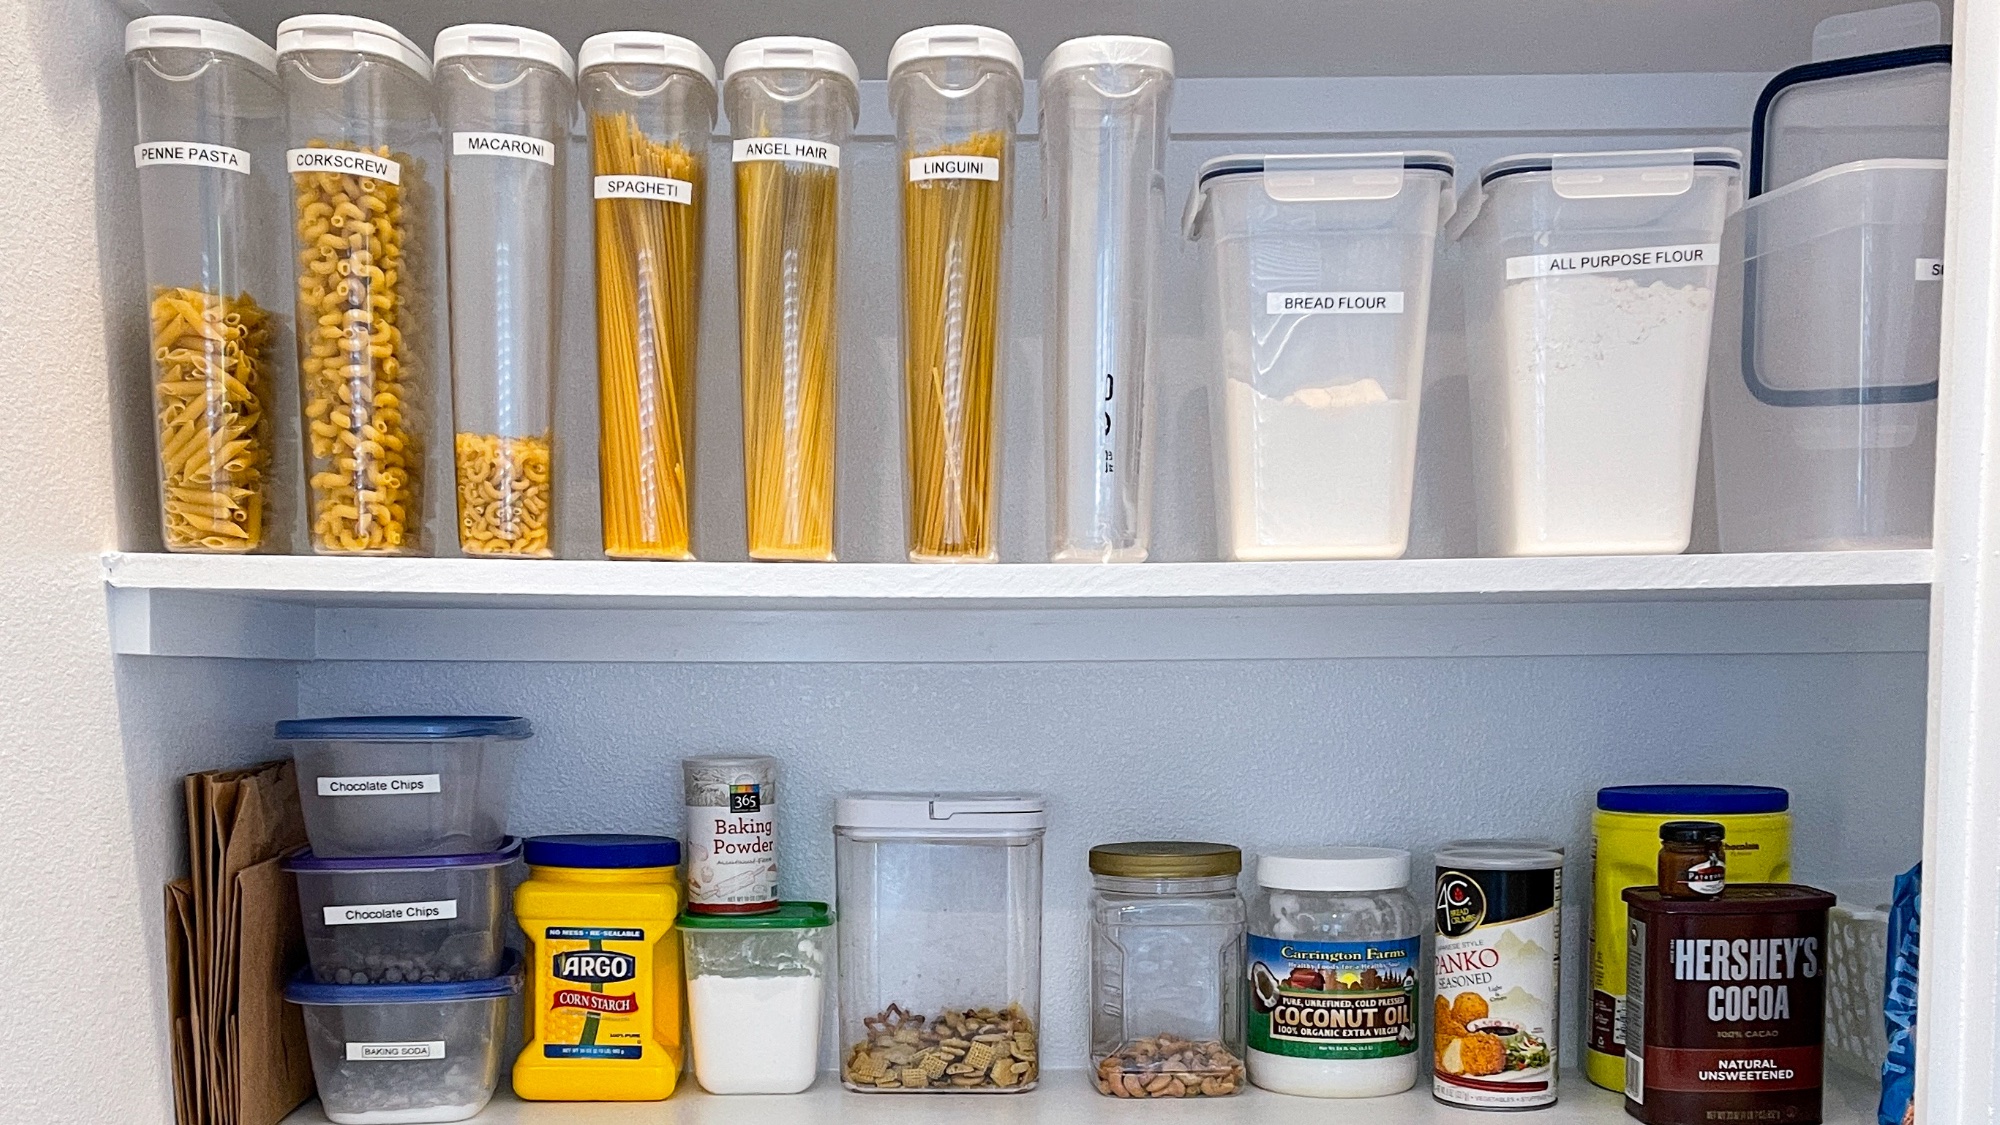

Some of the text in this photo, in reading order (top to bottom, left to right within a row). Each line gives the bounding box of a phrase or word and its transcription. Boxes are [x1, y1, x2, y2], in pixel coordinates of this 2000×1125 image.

[468, 138, 544, 157] MACARONI
[746, 143, 827, 159] ANGEL HAIR
[141, 147, 238, 166] PENNE PASTA
[296, 154, 388, 175] CORKSCREW
[924, 161, 983, 174] LINGUINI
[607, 180, 678, 197] SPAGHETI
[1549, 248, 1704, 271] ALL PURPOSE FLOUR
[1284, 296, 1387, 310] BREAD FLOUR
[330, 780, 424, 792] Chocolate Chips
[734, 794, 757, 809] 365
[714, 817, 772, 836] Baking
[713, 836, 774, 855] Powder
[345, 906, 439, 920] Chocolate Chips
[1280, 946, 1406, 961] Carrington Farms
[1675, 937, 1818, 981] HERSHEY'S
[563, 956, 628, 978] ARGO
[1438, 972, 1492, 989] SEASONED
[559, 992, 630, 1012] CORN STARCH
[1282, 996, 1405, 1009] PURE, UNREFINED, COLD PRESSED
[1708, 985, 1790, 1021] COCOA
[1274, 1004, 1410, 1028] COCONUT OIL
[1278, 1025, 1298, 1035] 100%
[1300, 1027, 1340, 1038] ORGANIC
[1342, 1027, 1371, 1037] EXTRA
[1744, 1030, 1779, 1038] CACAO
[364, 1047, 428, 1056] BAKING SODA
[1718, 1059, 1778, 1069] NATURAL
[1698, 1069, 1794, 1081] UNSWEETENED
